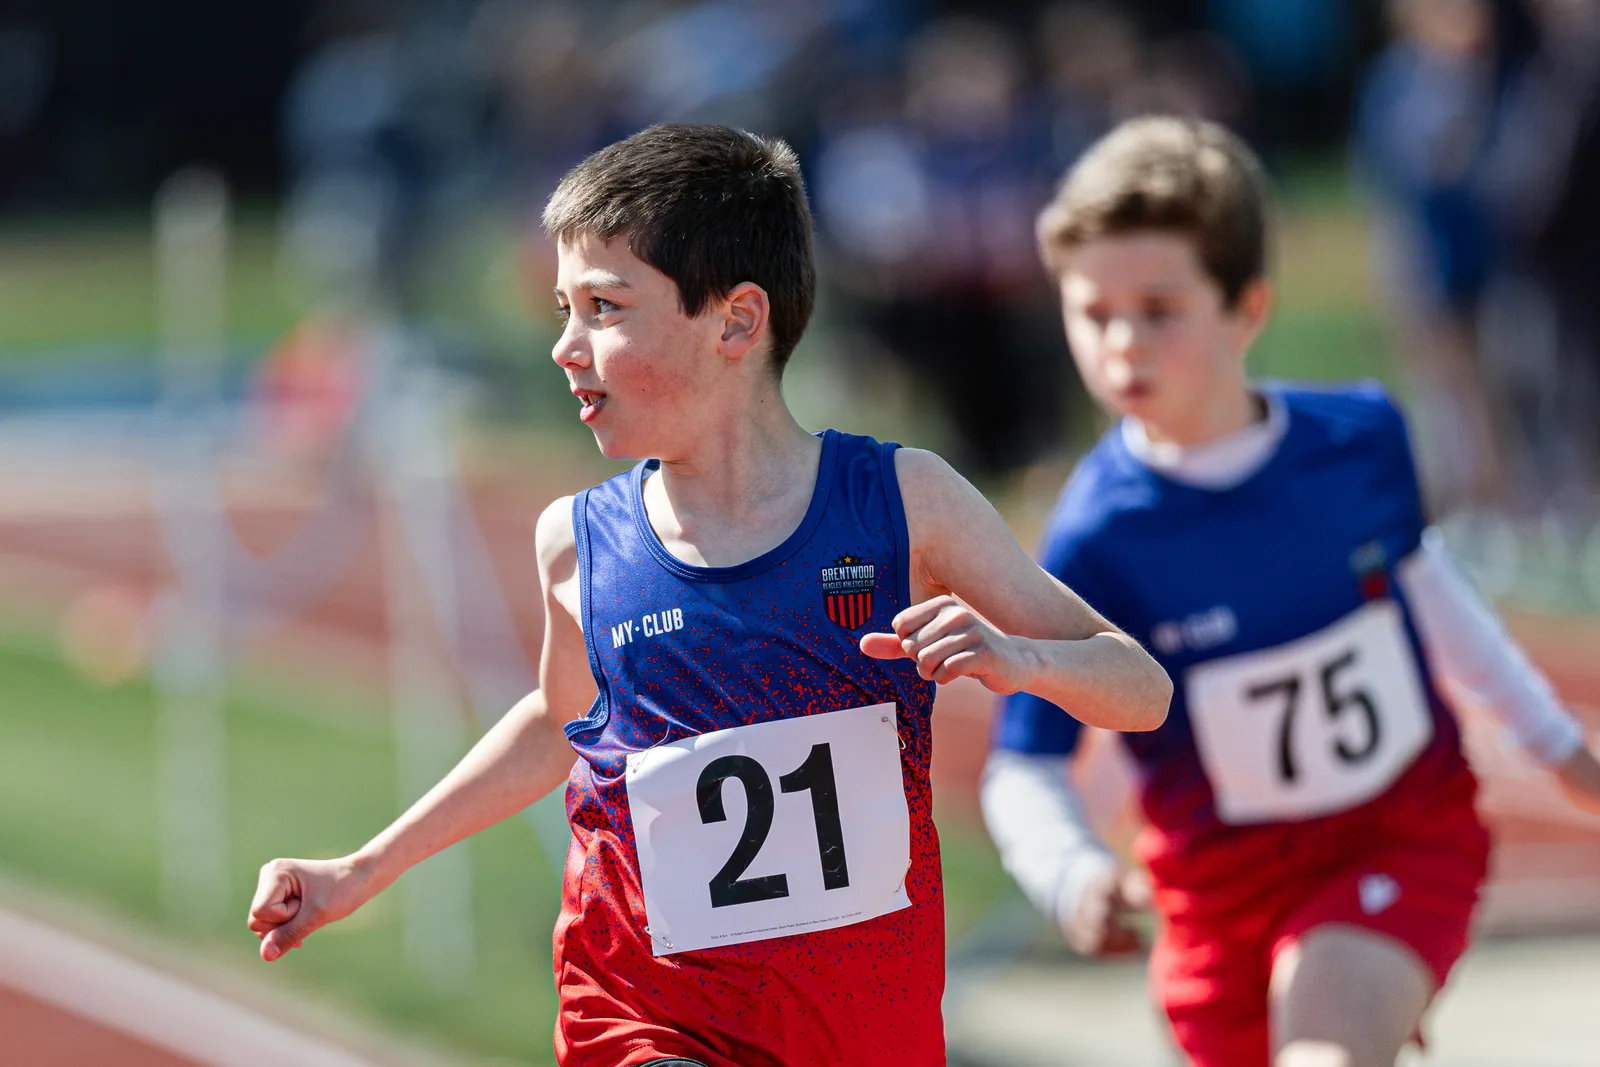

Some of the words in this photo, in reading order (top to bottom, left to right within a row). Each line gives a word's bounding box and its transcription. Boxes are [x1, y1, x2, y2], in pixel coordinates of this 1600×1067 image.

[821, 564, 875, 582] BRENTWOOD
[1245, 649, 1380, 784] 75
[696, 742, 850, 909] 21
